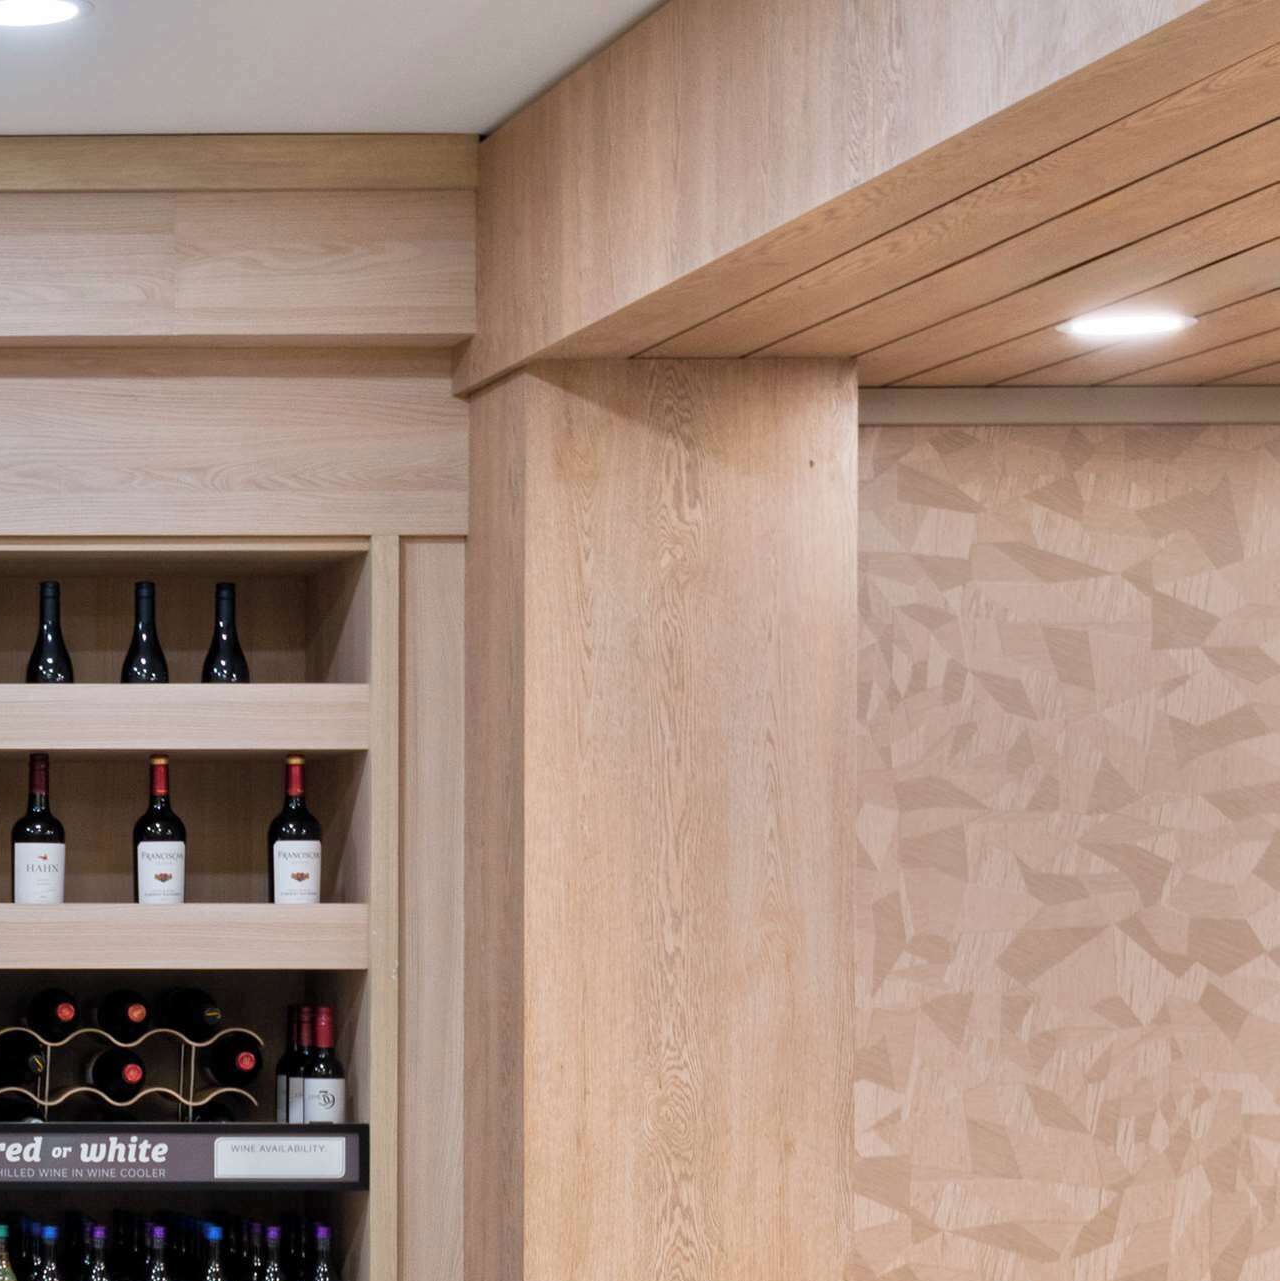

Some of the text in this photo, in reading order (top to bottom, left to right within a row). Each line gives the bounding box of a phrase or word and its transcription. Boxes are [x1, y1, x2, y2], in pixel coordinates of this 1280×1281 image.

[51, 1145, 72, 1160] or
[80, 1136, 169, 1163] white
[231, 1144, 256, 1154] WINE
[39, 1168, 69, 1179] WINE
[72, 1168, 83, 1178] IN
[86, 1168, 116, 1178] WINE
[119, 1168, 166, 1178] COOLER
